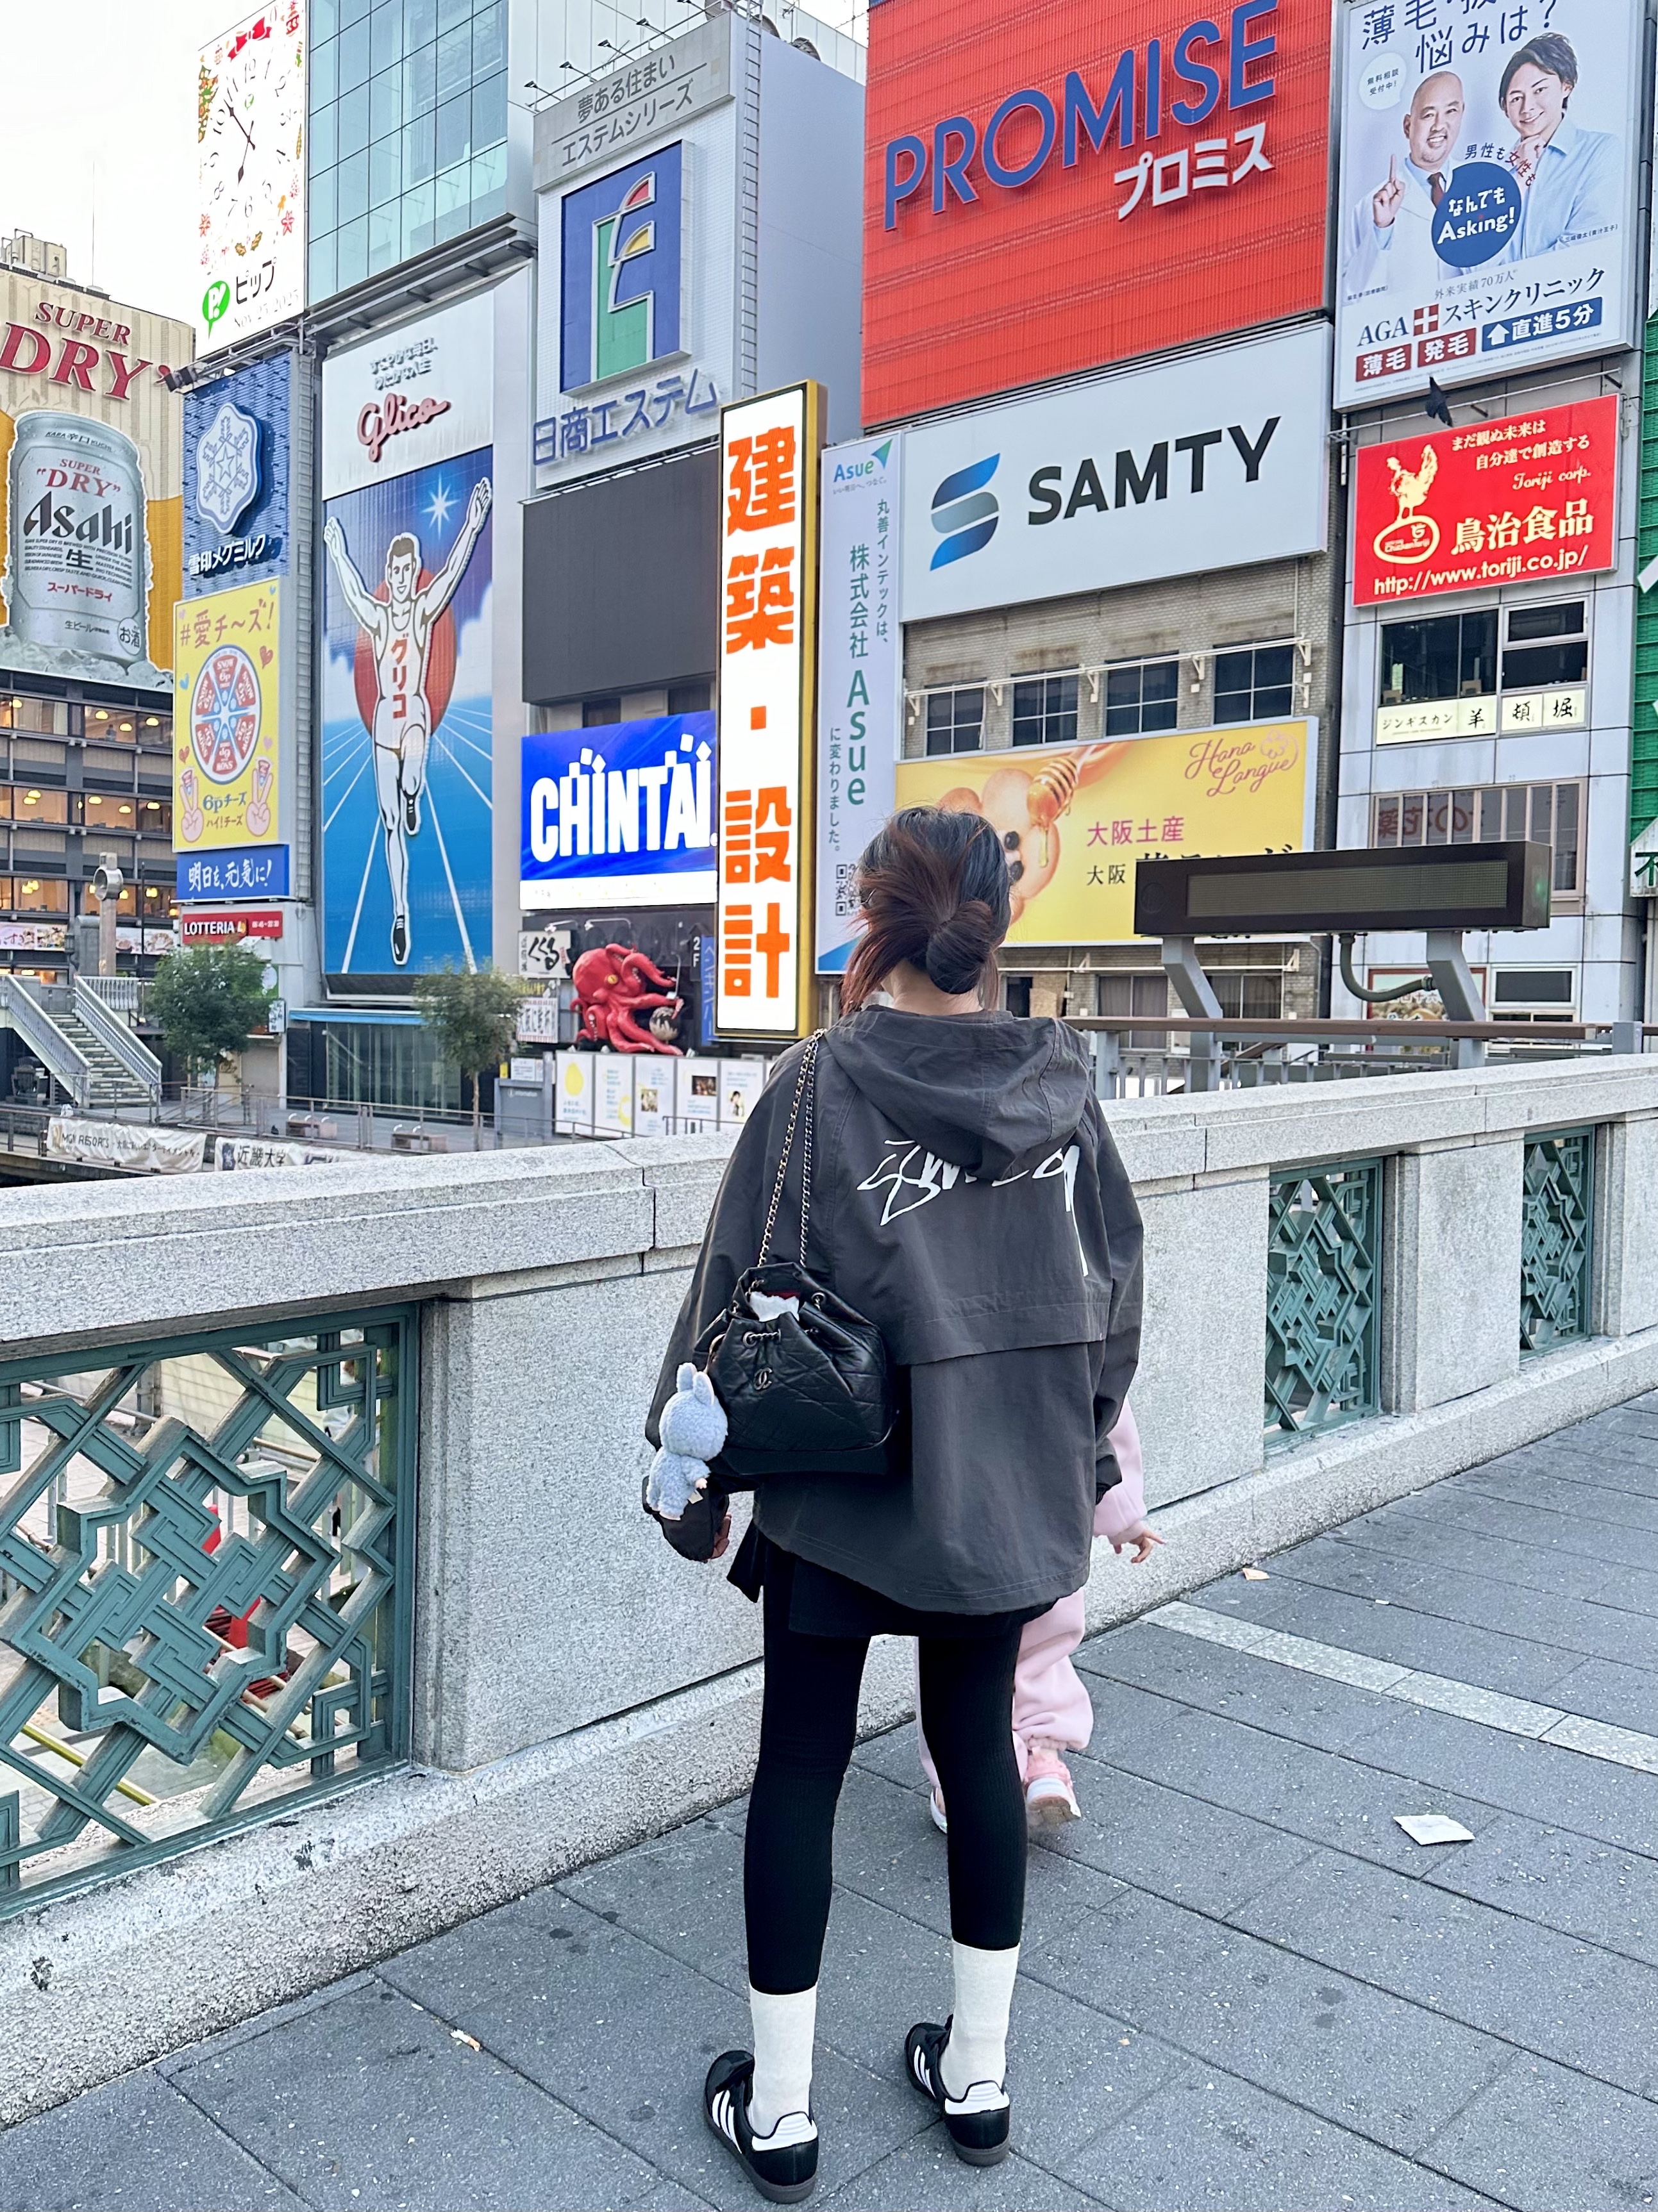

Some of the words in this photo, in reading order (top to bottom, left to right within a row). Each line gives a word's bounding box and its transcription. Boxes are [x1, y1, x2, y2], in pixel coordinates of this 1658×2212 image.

[578, 54, 675, 124] 夢ある住まい
[562, 78, 694, 167] エステムシリーズ
[884, 0, 1280, 231] PROMISE
[1114, 122, 1274, 222] プロミス
[1448, 187, 1505, 217] なんでも
[1437, 206, 1515, 244] Asking!
[236, 256, 278, 305] ピップ
[35, 301, 131, 346] SUPER
[1357, 315, 1410, 347] AGA
[1442, 267, 1605, 326] スキンクリニック
[1363, 348, 1407, 377] 薄毛
[1424, 332, 1470, 363] 発毛
[1511, 303, 1595, 341] 直進5分
[357, 392, 452, 463] Glico
[533, 368, 717, 466] 日商エステム
[1452, 419, 1546, 451] まだ観ぬ未来は
[60, 458, 101, 476] SUPER
[833, 460, 875, 483] Asue
[1028, 416, 1282, 526] SAMTY
[1476, 434, 1590, 470] 自分達で創造する
[1512, 471, 1553, 490] Toriji
[23, 490, 132, 555] Asahi
[1450, 497, 1595, 556] 鳥治食品
[65, 549, 94, 570] 生
[188, 533, 266, 576] 雪印メグミルク
[876, 498, 890, 644] 丸善インテックは、
[1373, 544, 1589, 595] http://www.toriji.co.jp/
[47, 582, 113, 603] スーパードライ
[850, 543, 870, 660] 株式会社
[119, 625, 140, 649] お酒
[390, 631, 410, 720] グリコ
[724, 426, 796, 999] 建築・設計
[1382, 714, 1453, 730] ジンギスカン
[846, 669, 870, 806] Asue
[1184, 738, 1255, 779] Hana
[828, 727, 841, 852] に変わりました。
[1206, 758, 1291, 798] Langue
[1086, 815, 1185, 847] 大阪土産
[1086, 863, 1126, 886] 大阪
[183, 920, 234, 936] LOTTERIA
[528, 936, 560, 970] くくる
[692, 936, 700, 968] 2F
[237, 1145, 287, 1168] 近畿大学
